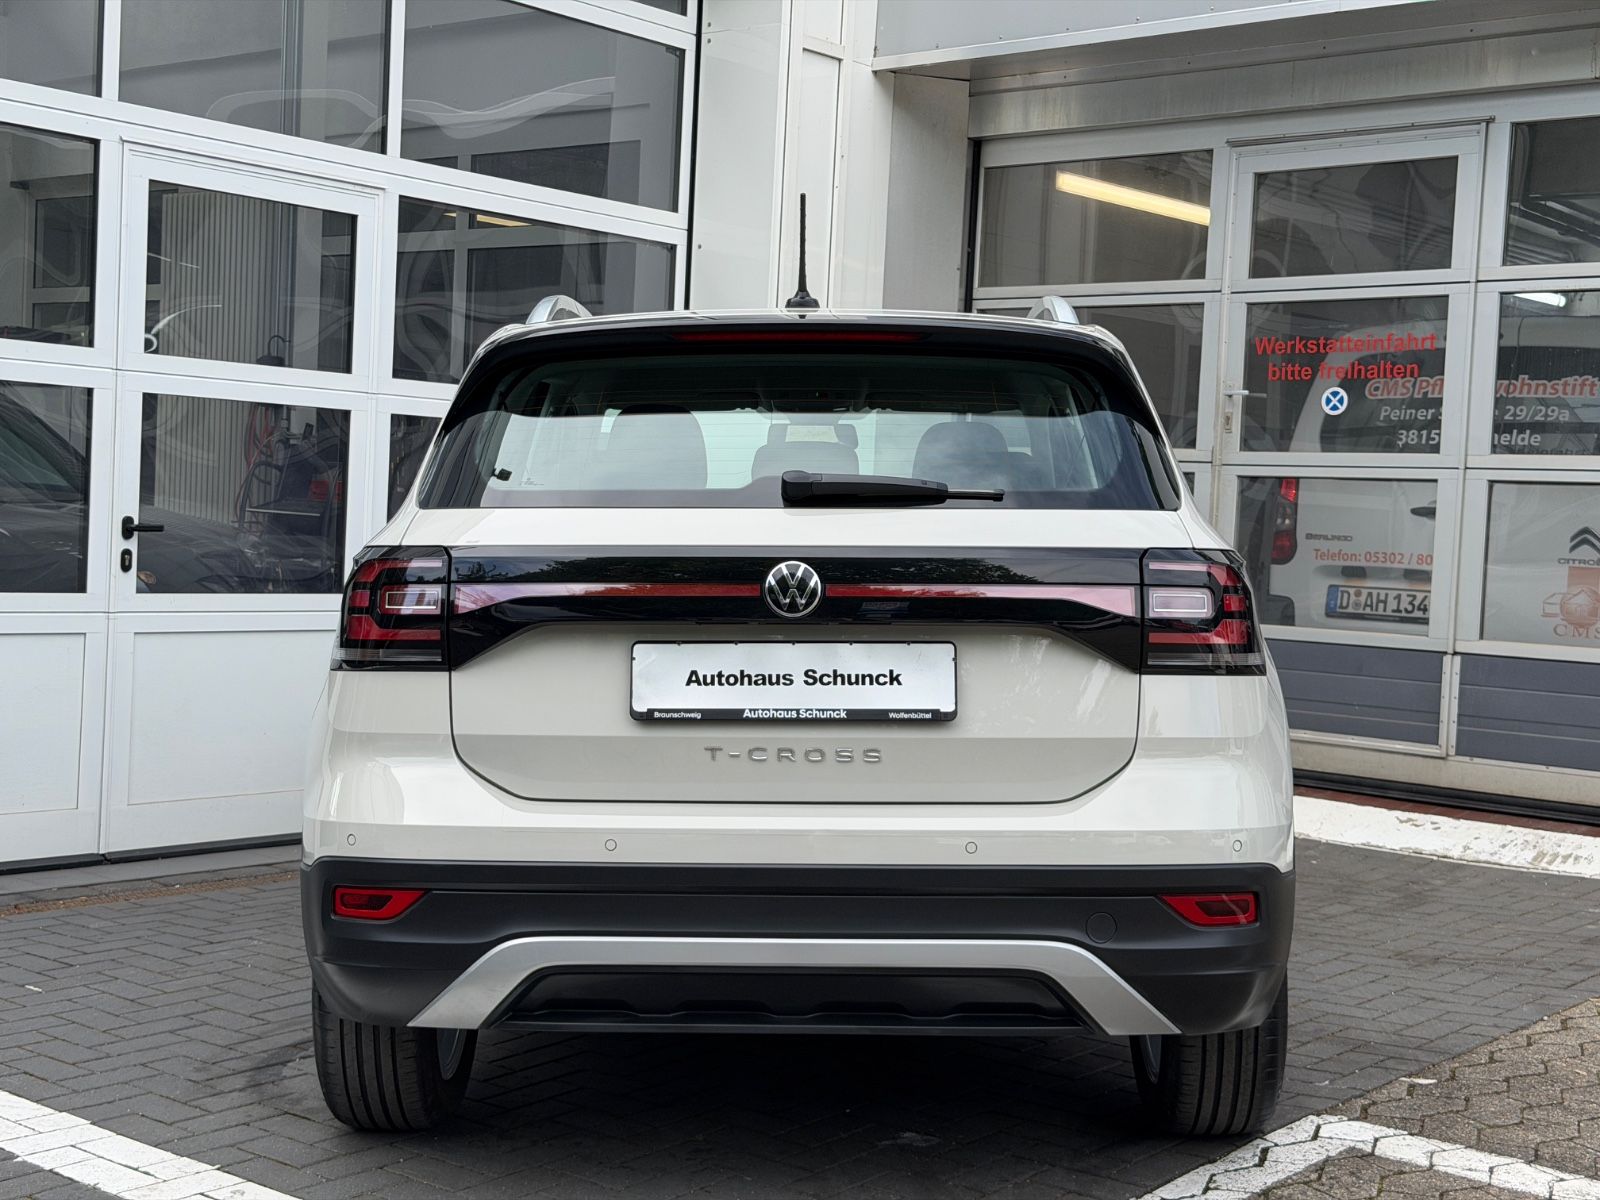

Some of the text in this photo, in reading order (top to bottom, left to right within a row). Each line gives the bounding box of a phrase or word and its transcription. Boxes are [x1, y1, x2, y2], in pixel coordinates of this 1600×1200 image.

[1255, 332, 1438, 355] Werkstatteinfahrt
[1268, 360, 1419, 381] bitte freihalten
[1365, 378, 1413, 399] CMS
[1379, 406, 1434, 421] Peiner
[1504, 405, 1569, 422] 29/29a
[1397, 429, 1440, 445] 3815
[1313, 549, 1361, 562] Telefon:
[1364, 551, 1404, 564] 05302
[1416, 554, 1433, 565] 80
[1338, 590, 1428, 615] D AH 134
[685, 669, 902, 687] Autohaus Schunck
[653, 709, 932, 720] Braunschweig Autohaus Schunck Wolfenbüttel
[704, 747, 883, 762] T-CROSS
